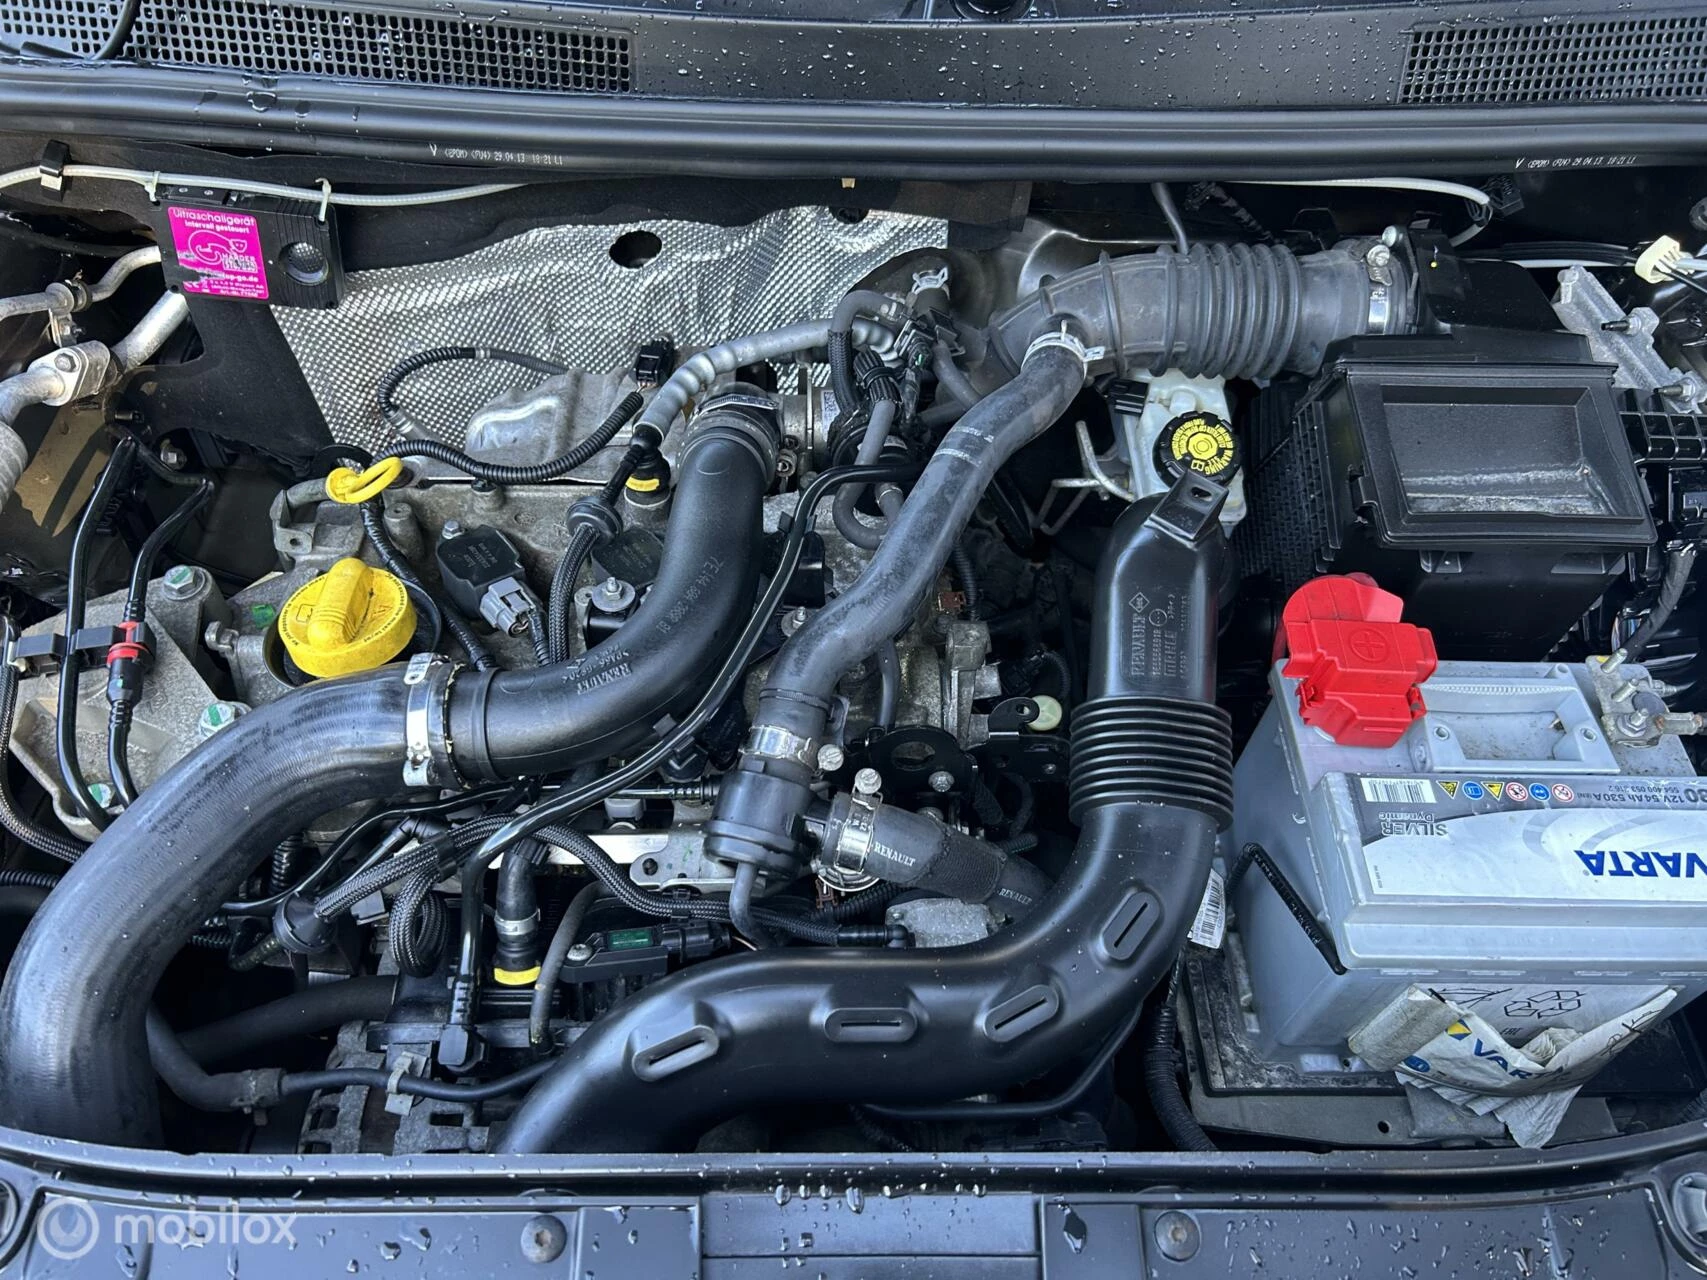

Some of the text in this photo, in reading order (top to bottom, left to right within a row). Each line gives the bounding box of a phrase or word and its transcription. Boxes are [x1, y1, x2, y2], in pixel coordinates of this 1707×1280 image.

[1205, 450, 1234, 475] WARNING
[577, 662, 632, 695] RENAULT
[1379, 811, 1434, 822] Dynamic
[1380, 822, 1449, 836] SILVER
[873, 841, 916, 868] RENAULT
[1574, 850, 1707, 878] VARTA
[998, 887, 1033, 905] RENAULT
